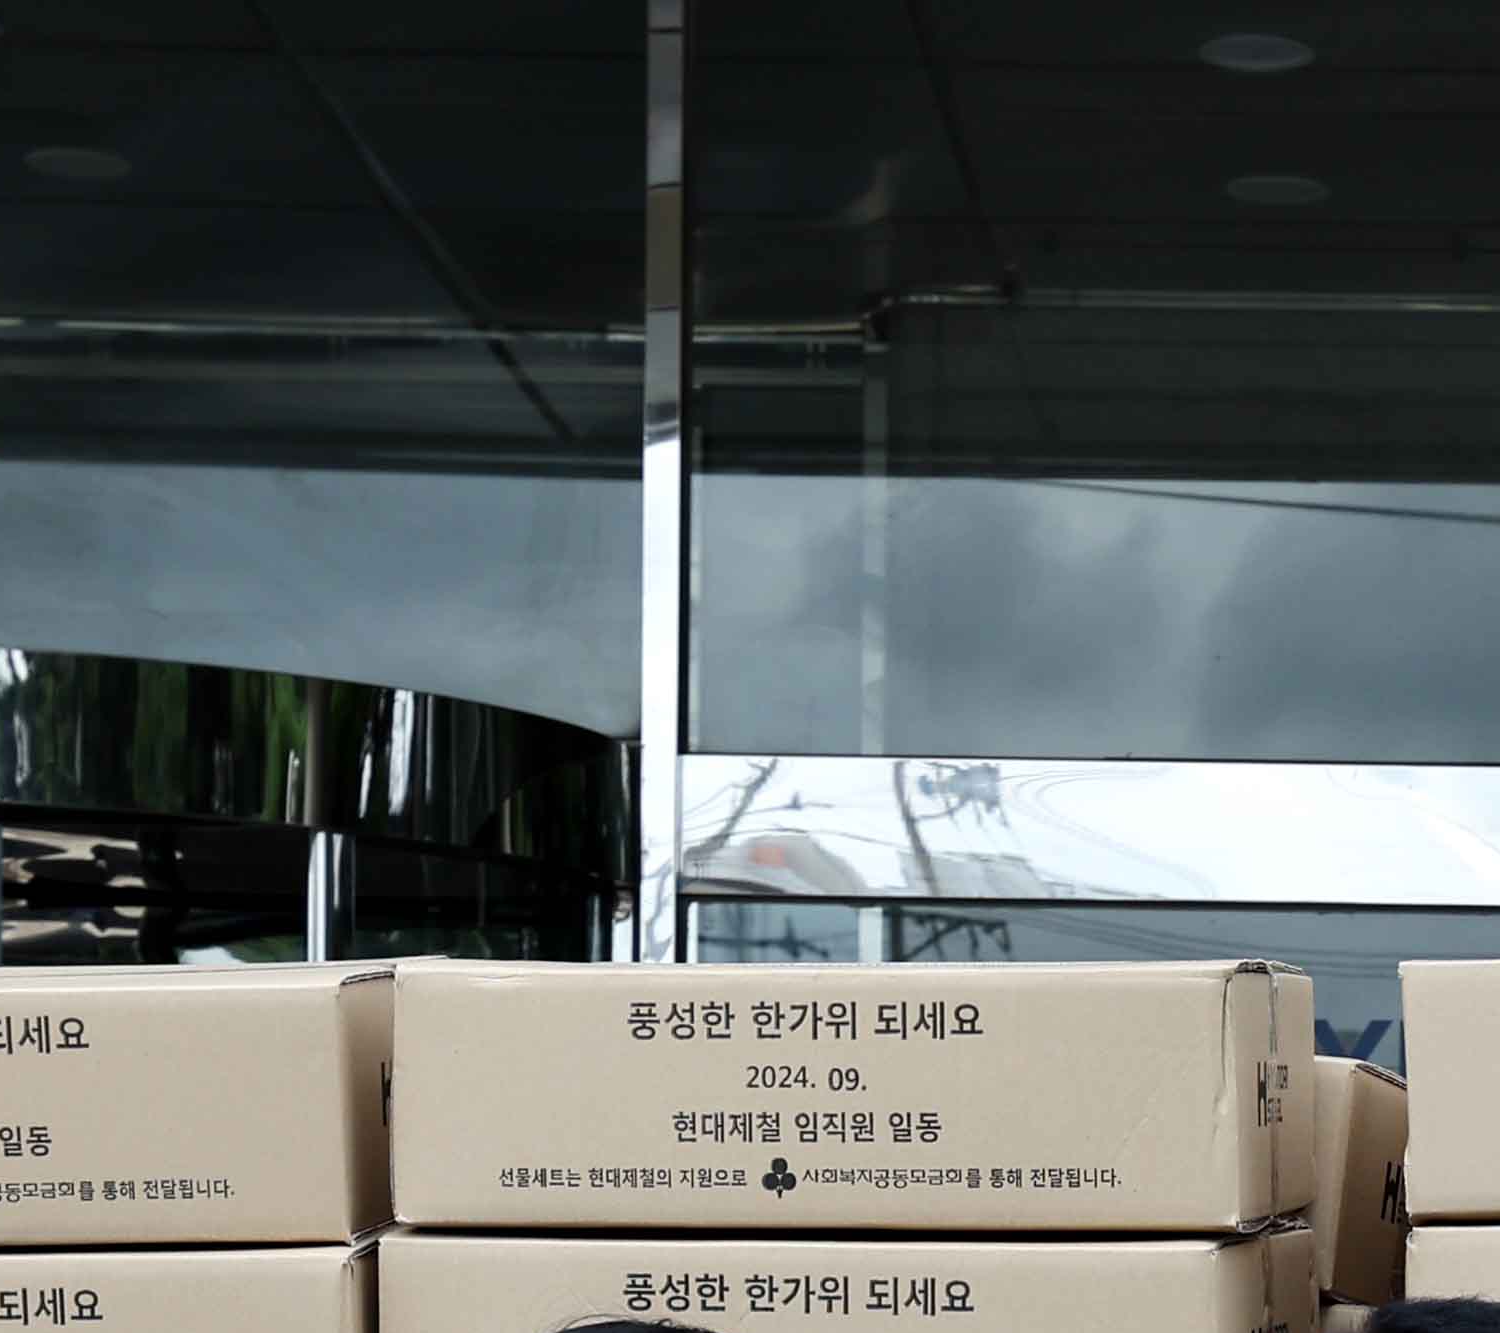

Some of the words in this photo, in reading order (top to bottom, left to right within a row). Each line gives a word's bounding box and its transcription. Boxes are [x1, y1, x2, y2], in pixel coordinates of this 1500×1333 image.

[627, 1000, 736, 1041] 풍성한
[750, 1000, 857, 1041] 한가위
[873, 1000, 984, 1041] 되세요
[746, 1065, 816, 1089] 2024.
[827, 1067, 867, 1092] 09.
[672, 1111, 781, 1144] 현대제철
[794, 1111, 875, 1144] 임직원
[888, 1111, 942, 1144] 일동
[499, 1167, 582, 1188] 선물세트는
[587, 1167, 672, 1189] 현대제철의
[679, 1167, 748, 1189] 지원으로
[989, 1168, 1023, 1189] 통해
[1030, 1167, 1122, 1189] 전달됩니다.
